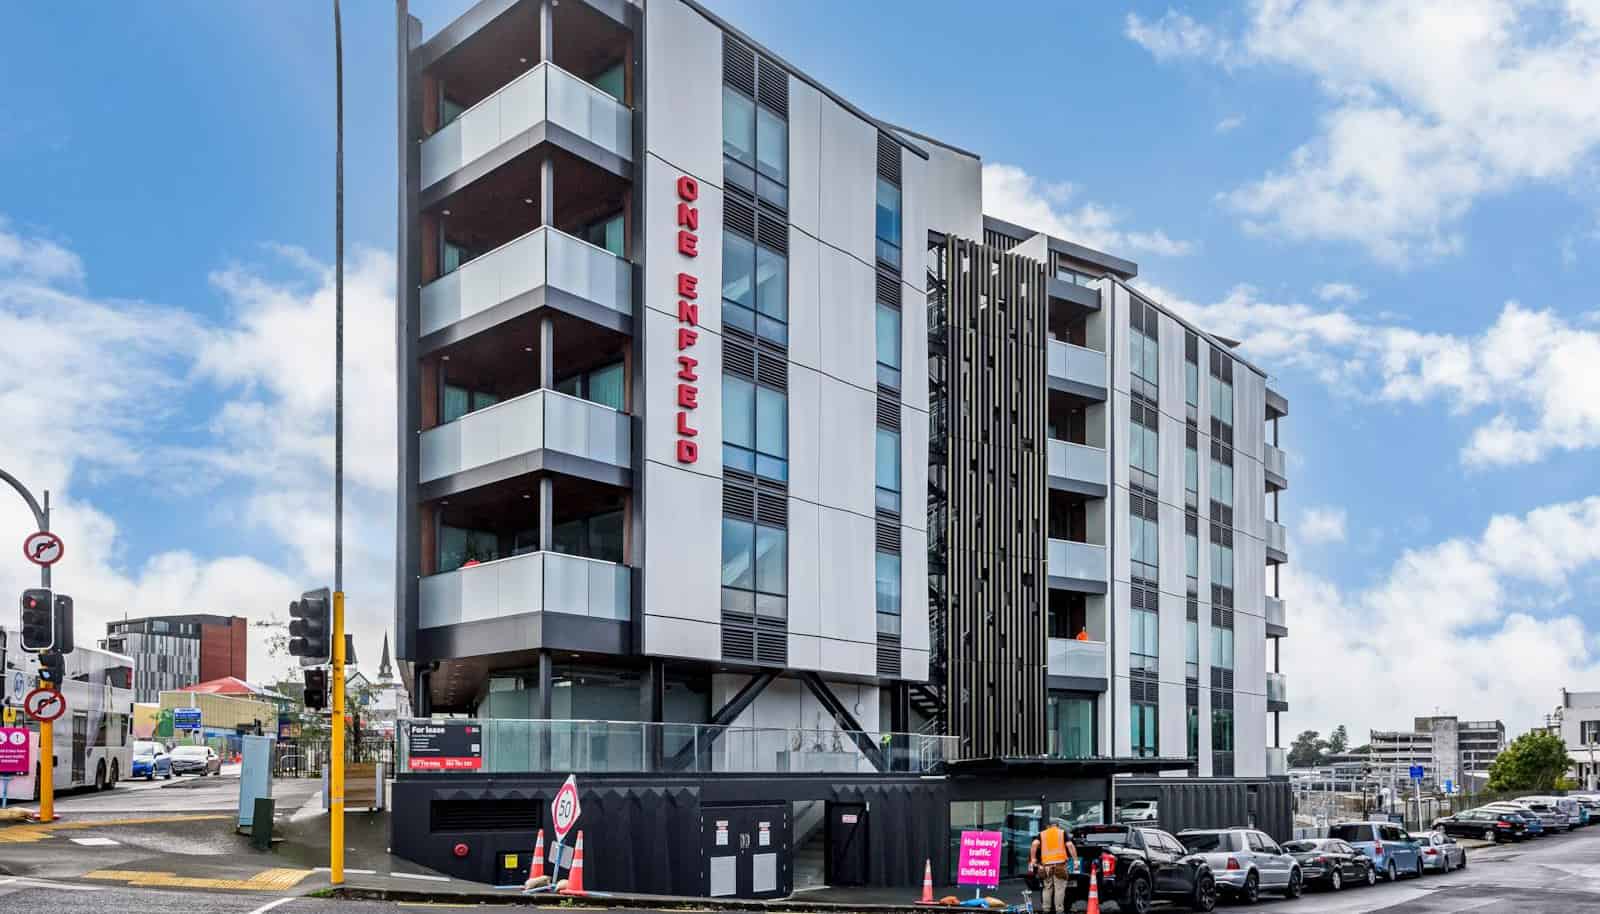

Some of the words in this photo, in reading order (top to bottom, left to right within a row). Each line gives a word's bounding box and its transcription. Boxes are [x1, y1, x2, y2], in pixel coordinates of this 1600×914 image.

[677, 175, 698, 258] ONE
[677, 272, 698, 464] ENFIELD
[425, 725, 446, 734] lease
[559, 799, 571, 818] 50
[964, 838, 974, 846] No
[976, 838, 998, 848] heavy
[969, 848, 992, 857] traffic
[961, 868, 987, 876] Enfield
[988, 869, 996, 877] St
